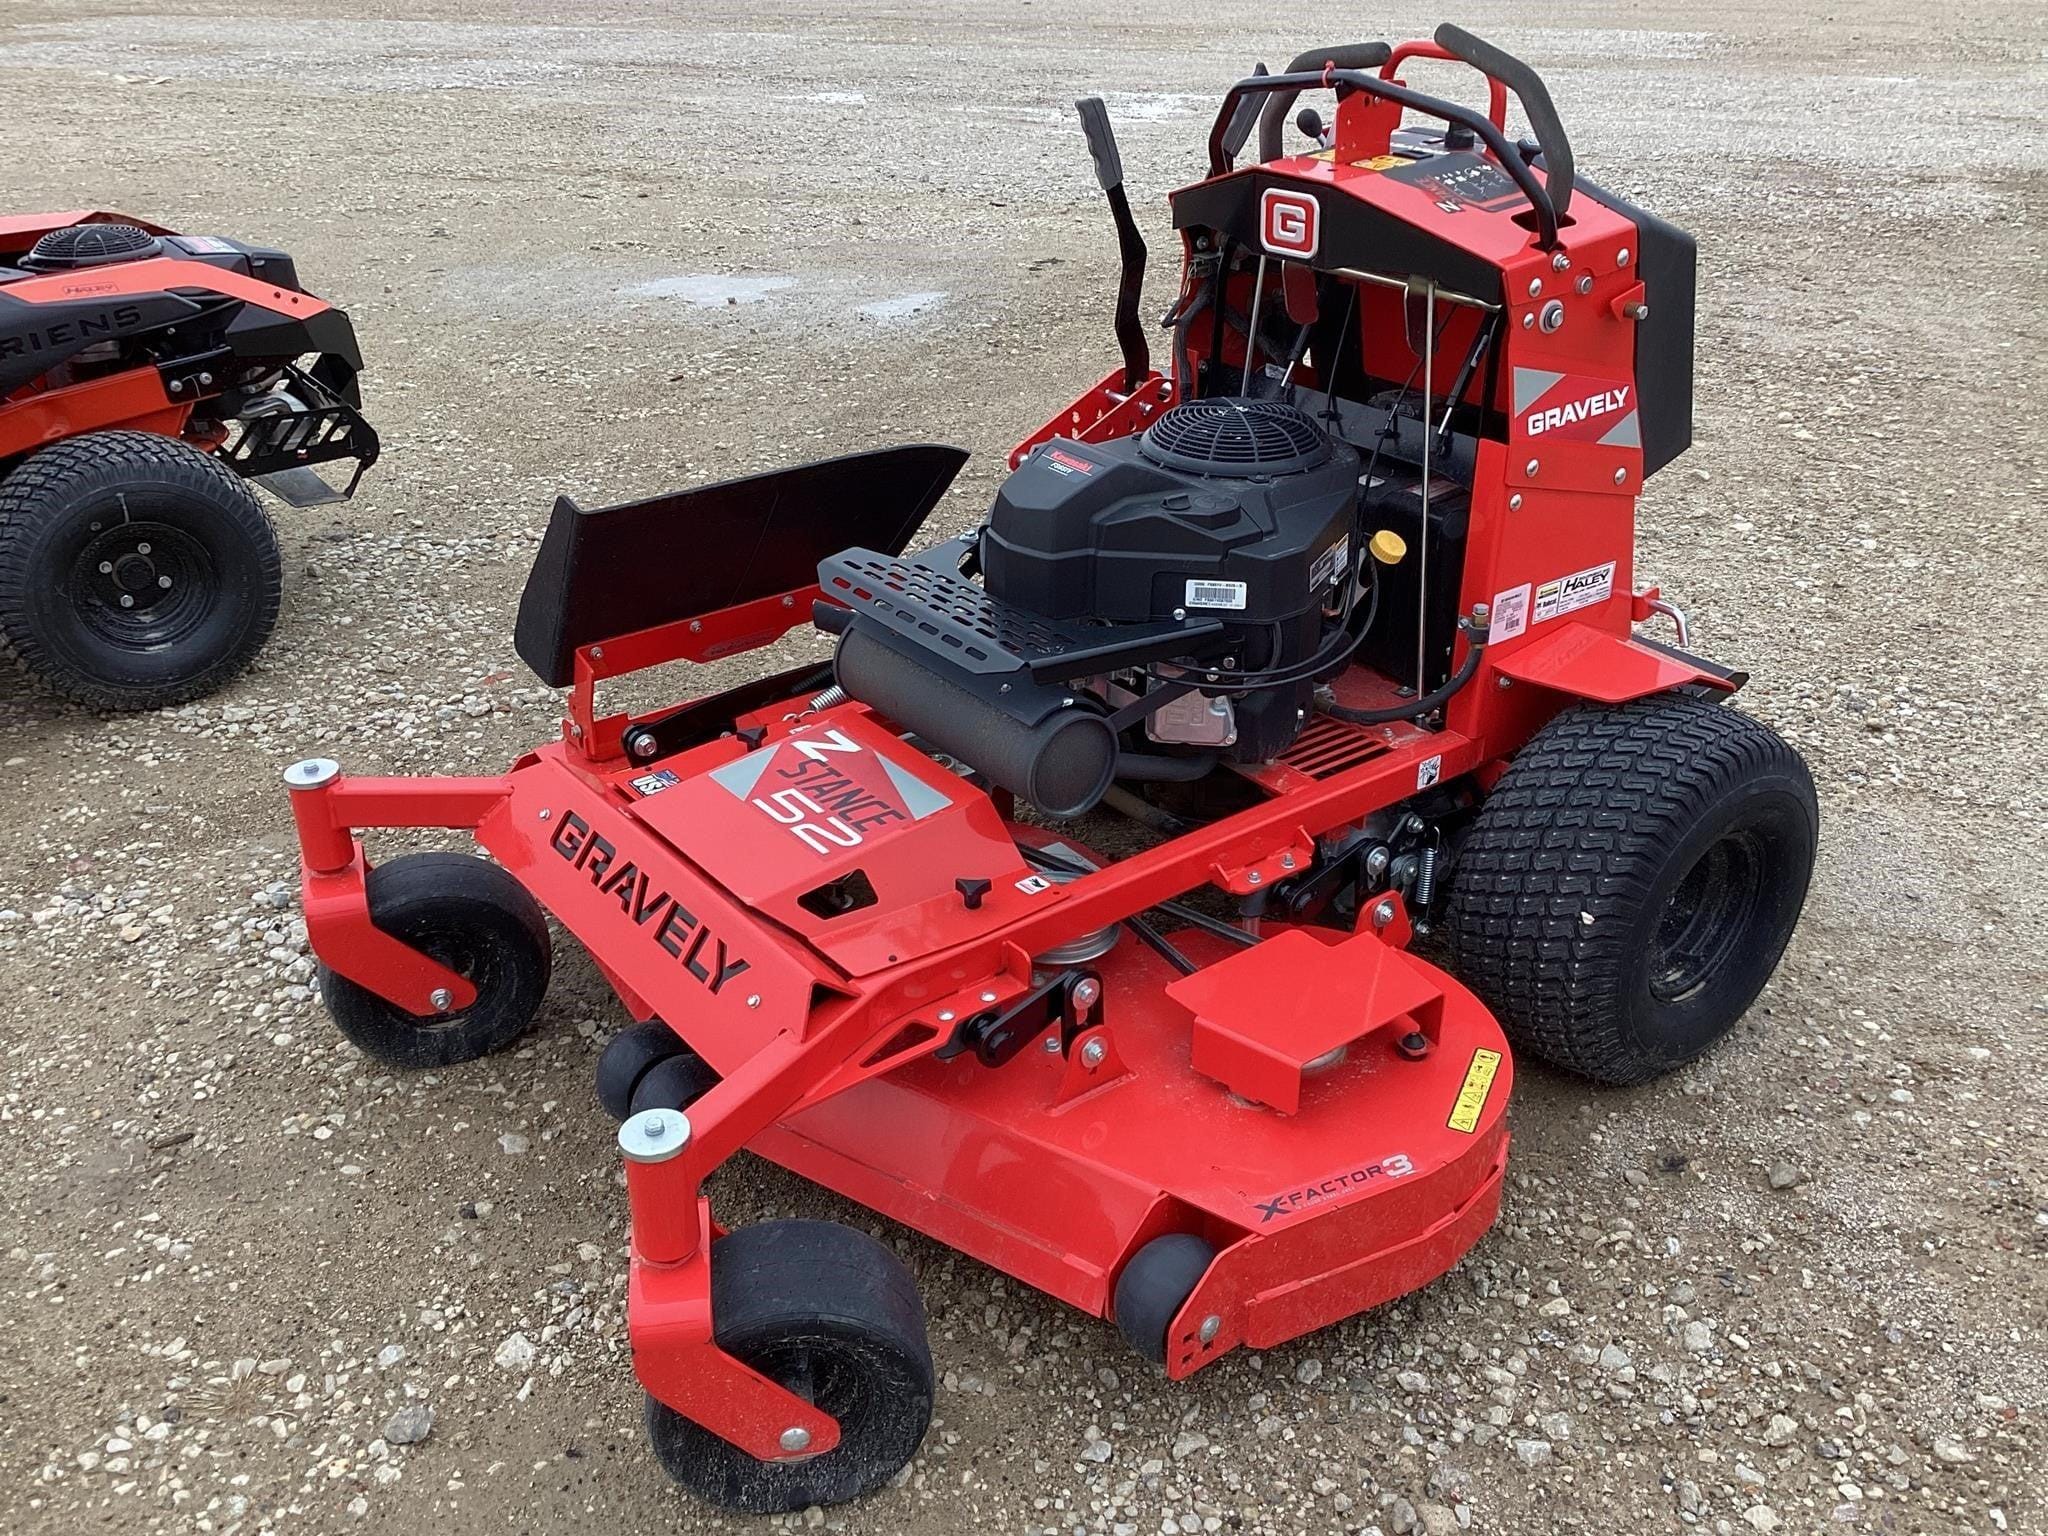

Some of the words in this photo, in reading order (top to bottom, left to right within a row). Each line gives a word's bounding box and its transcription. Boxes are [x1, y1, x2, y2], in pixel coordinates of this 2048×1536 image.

[1527, 385, 1630, 436] GRAVELY
[1563, 570, 1610, 594] HALEY
[791, 729, 863, 763] Z
[752, 788, 864, 855] 52
[776, 758, 907, 832] STANCE
[550, 810, 751, 995] GRAVELY
